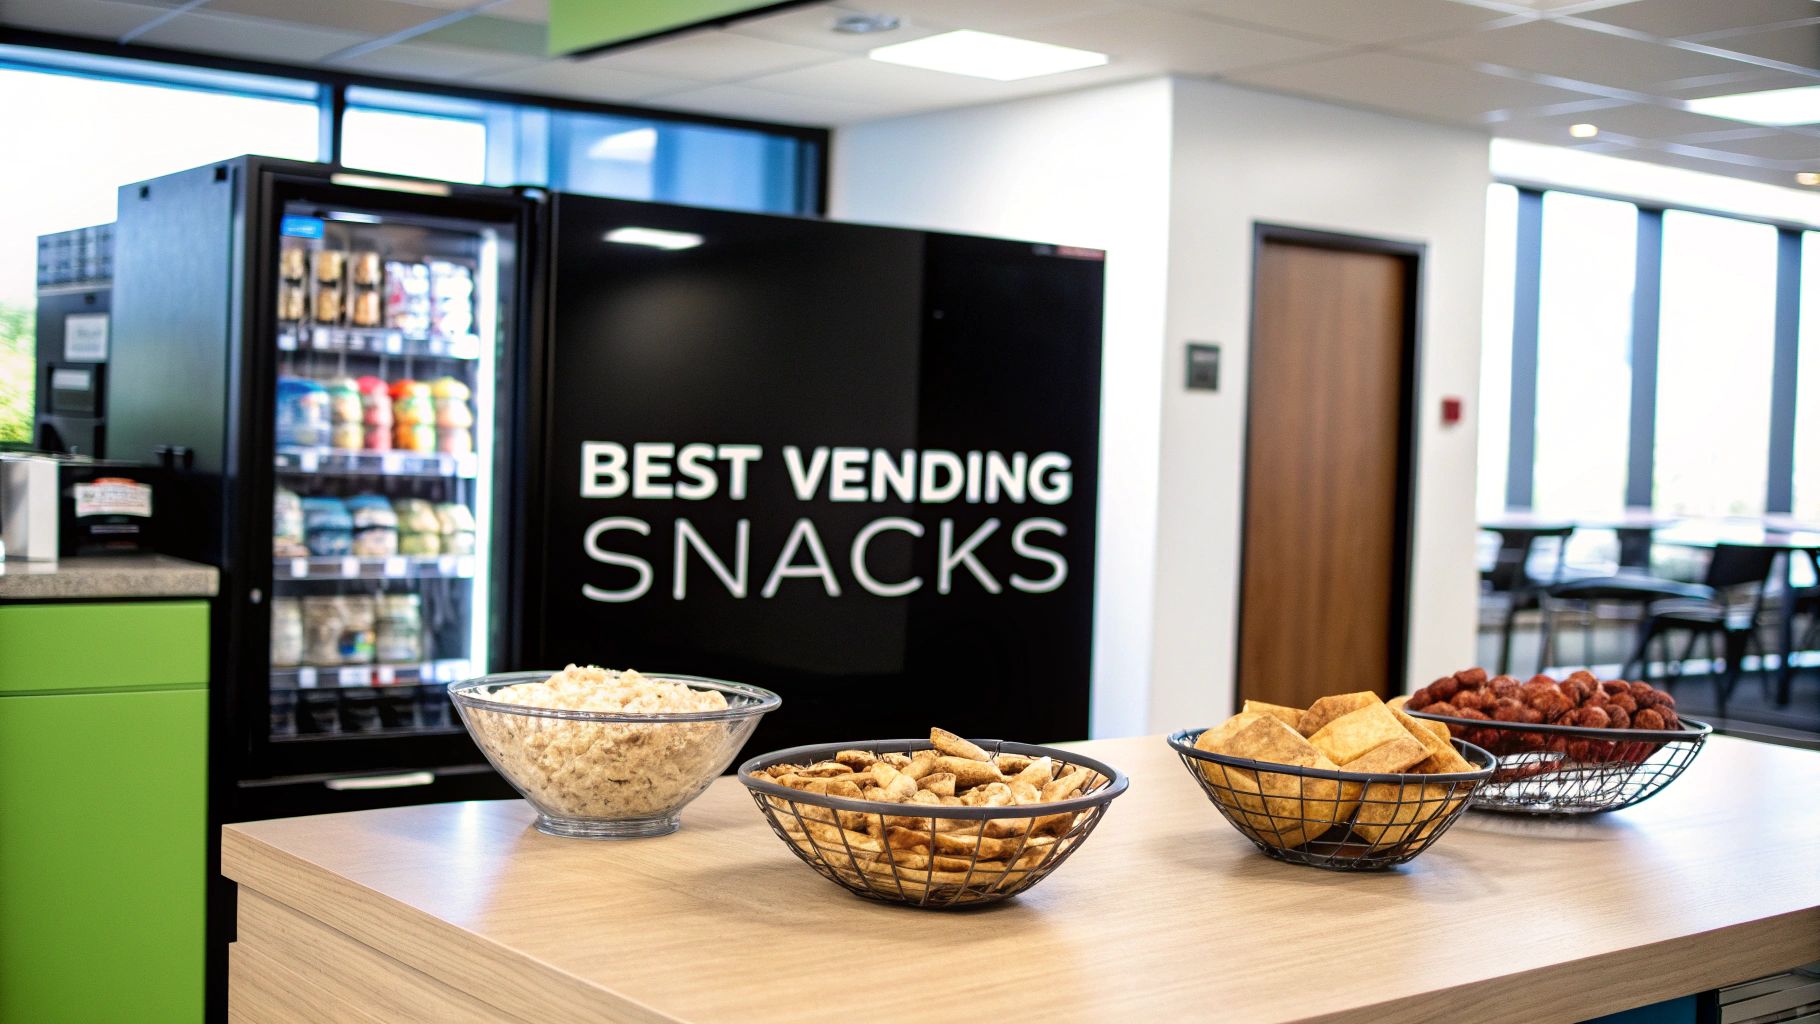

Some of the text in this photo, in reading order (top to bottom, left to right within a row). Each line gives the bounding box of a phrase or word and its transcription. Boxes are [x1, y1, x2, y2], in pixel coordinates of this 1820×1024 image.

[580, 440, 1072, 505] BEST VENDING
[582, 516, 1068, 602] SNACKS
